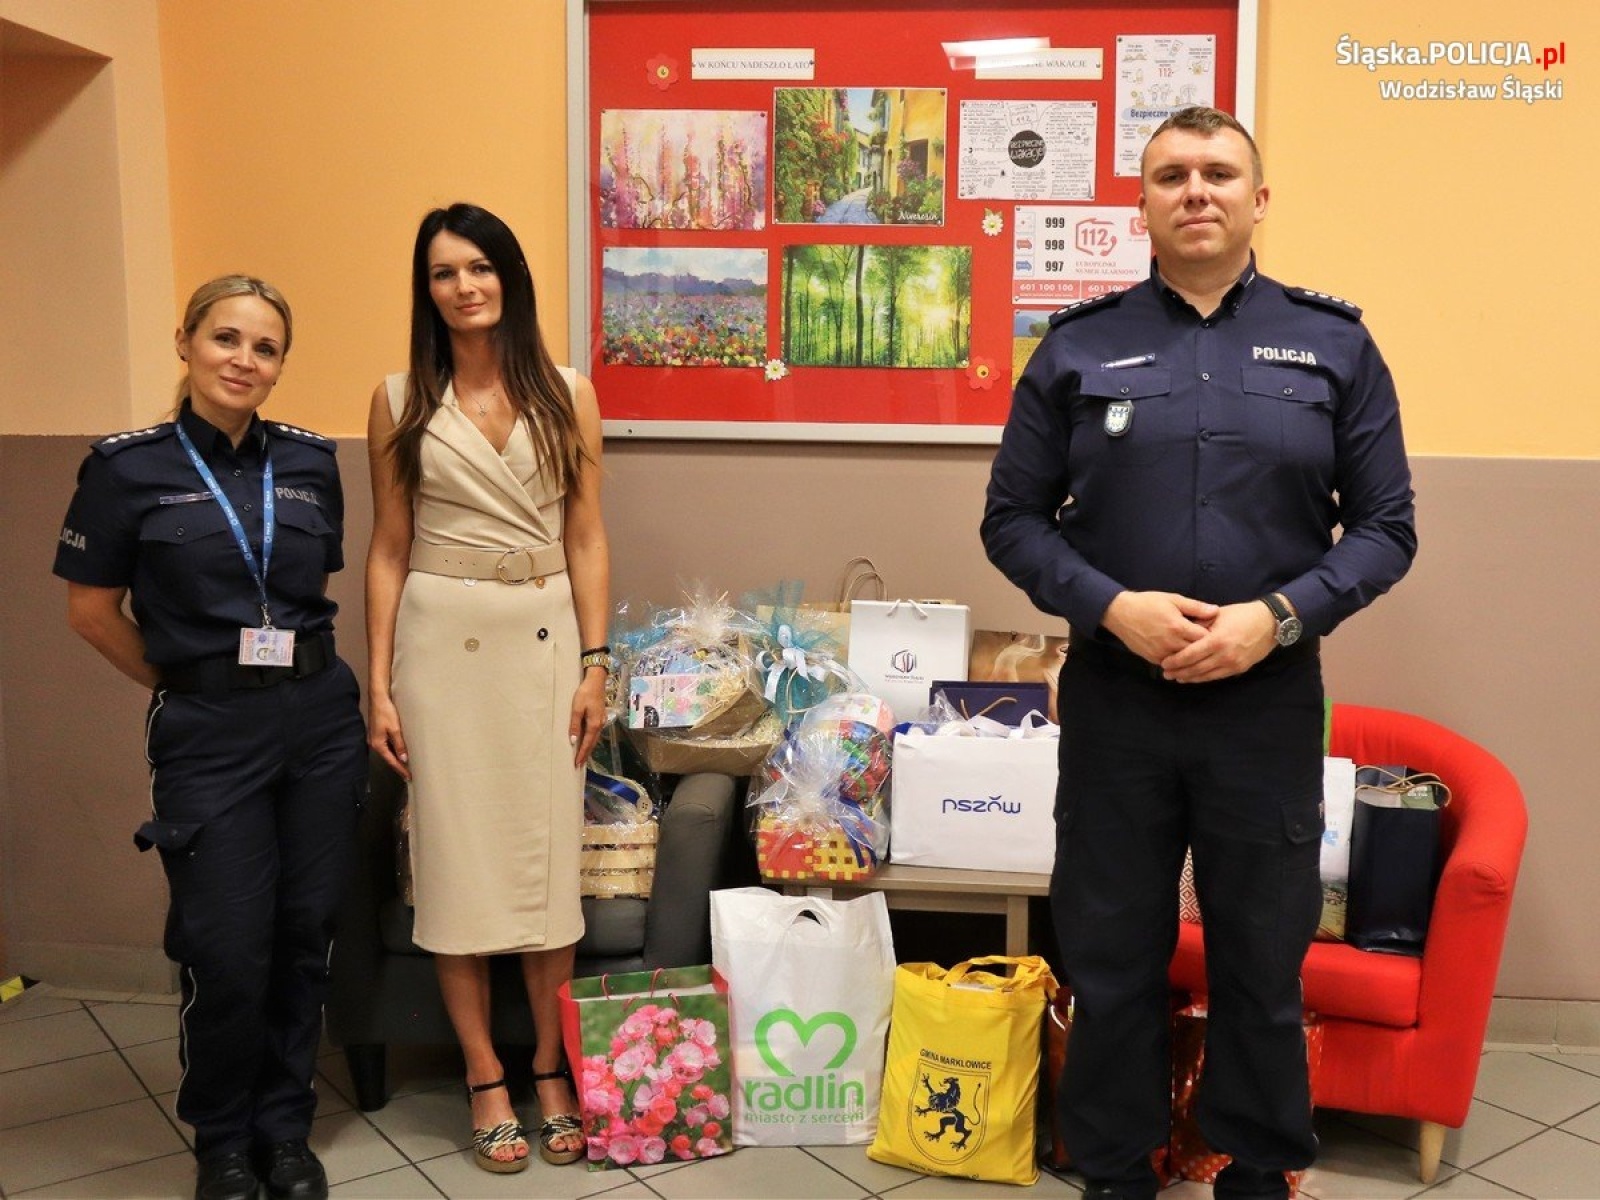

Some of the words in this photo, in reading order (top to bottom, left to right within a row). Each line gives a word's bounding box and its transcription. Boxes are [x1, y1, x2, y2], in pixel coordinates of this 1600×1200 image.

[698, 61, 707, 69] W
[1130, 108, 1168, 119] Bezpieczne
[1045, 217, 1065, 228] 999
[1081, 228, 1109, 246] 112
[1045, 239, 1065, 250] 998
[1045, 261, 1064, 272] 997
[1020, 283, 1036, 292] 601
[1039, 283, 1056, 292] 100
[1058, 284, 1074, 292] 100
[1088, 284, 1105, 293] 601
[1252, 345, 1318, 366] POLICJA
[939, 1055, 992, 1070] MARKLOWICE
[745, 1072, 864, 1111] radlin
[745, 1113, 796, 1124] miasto
[799, 1114, 808, 1124] z
